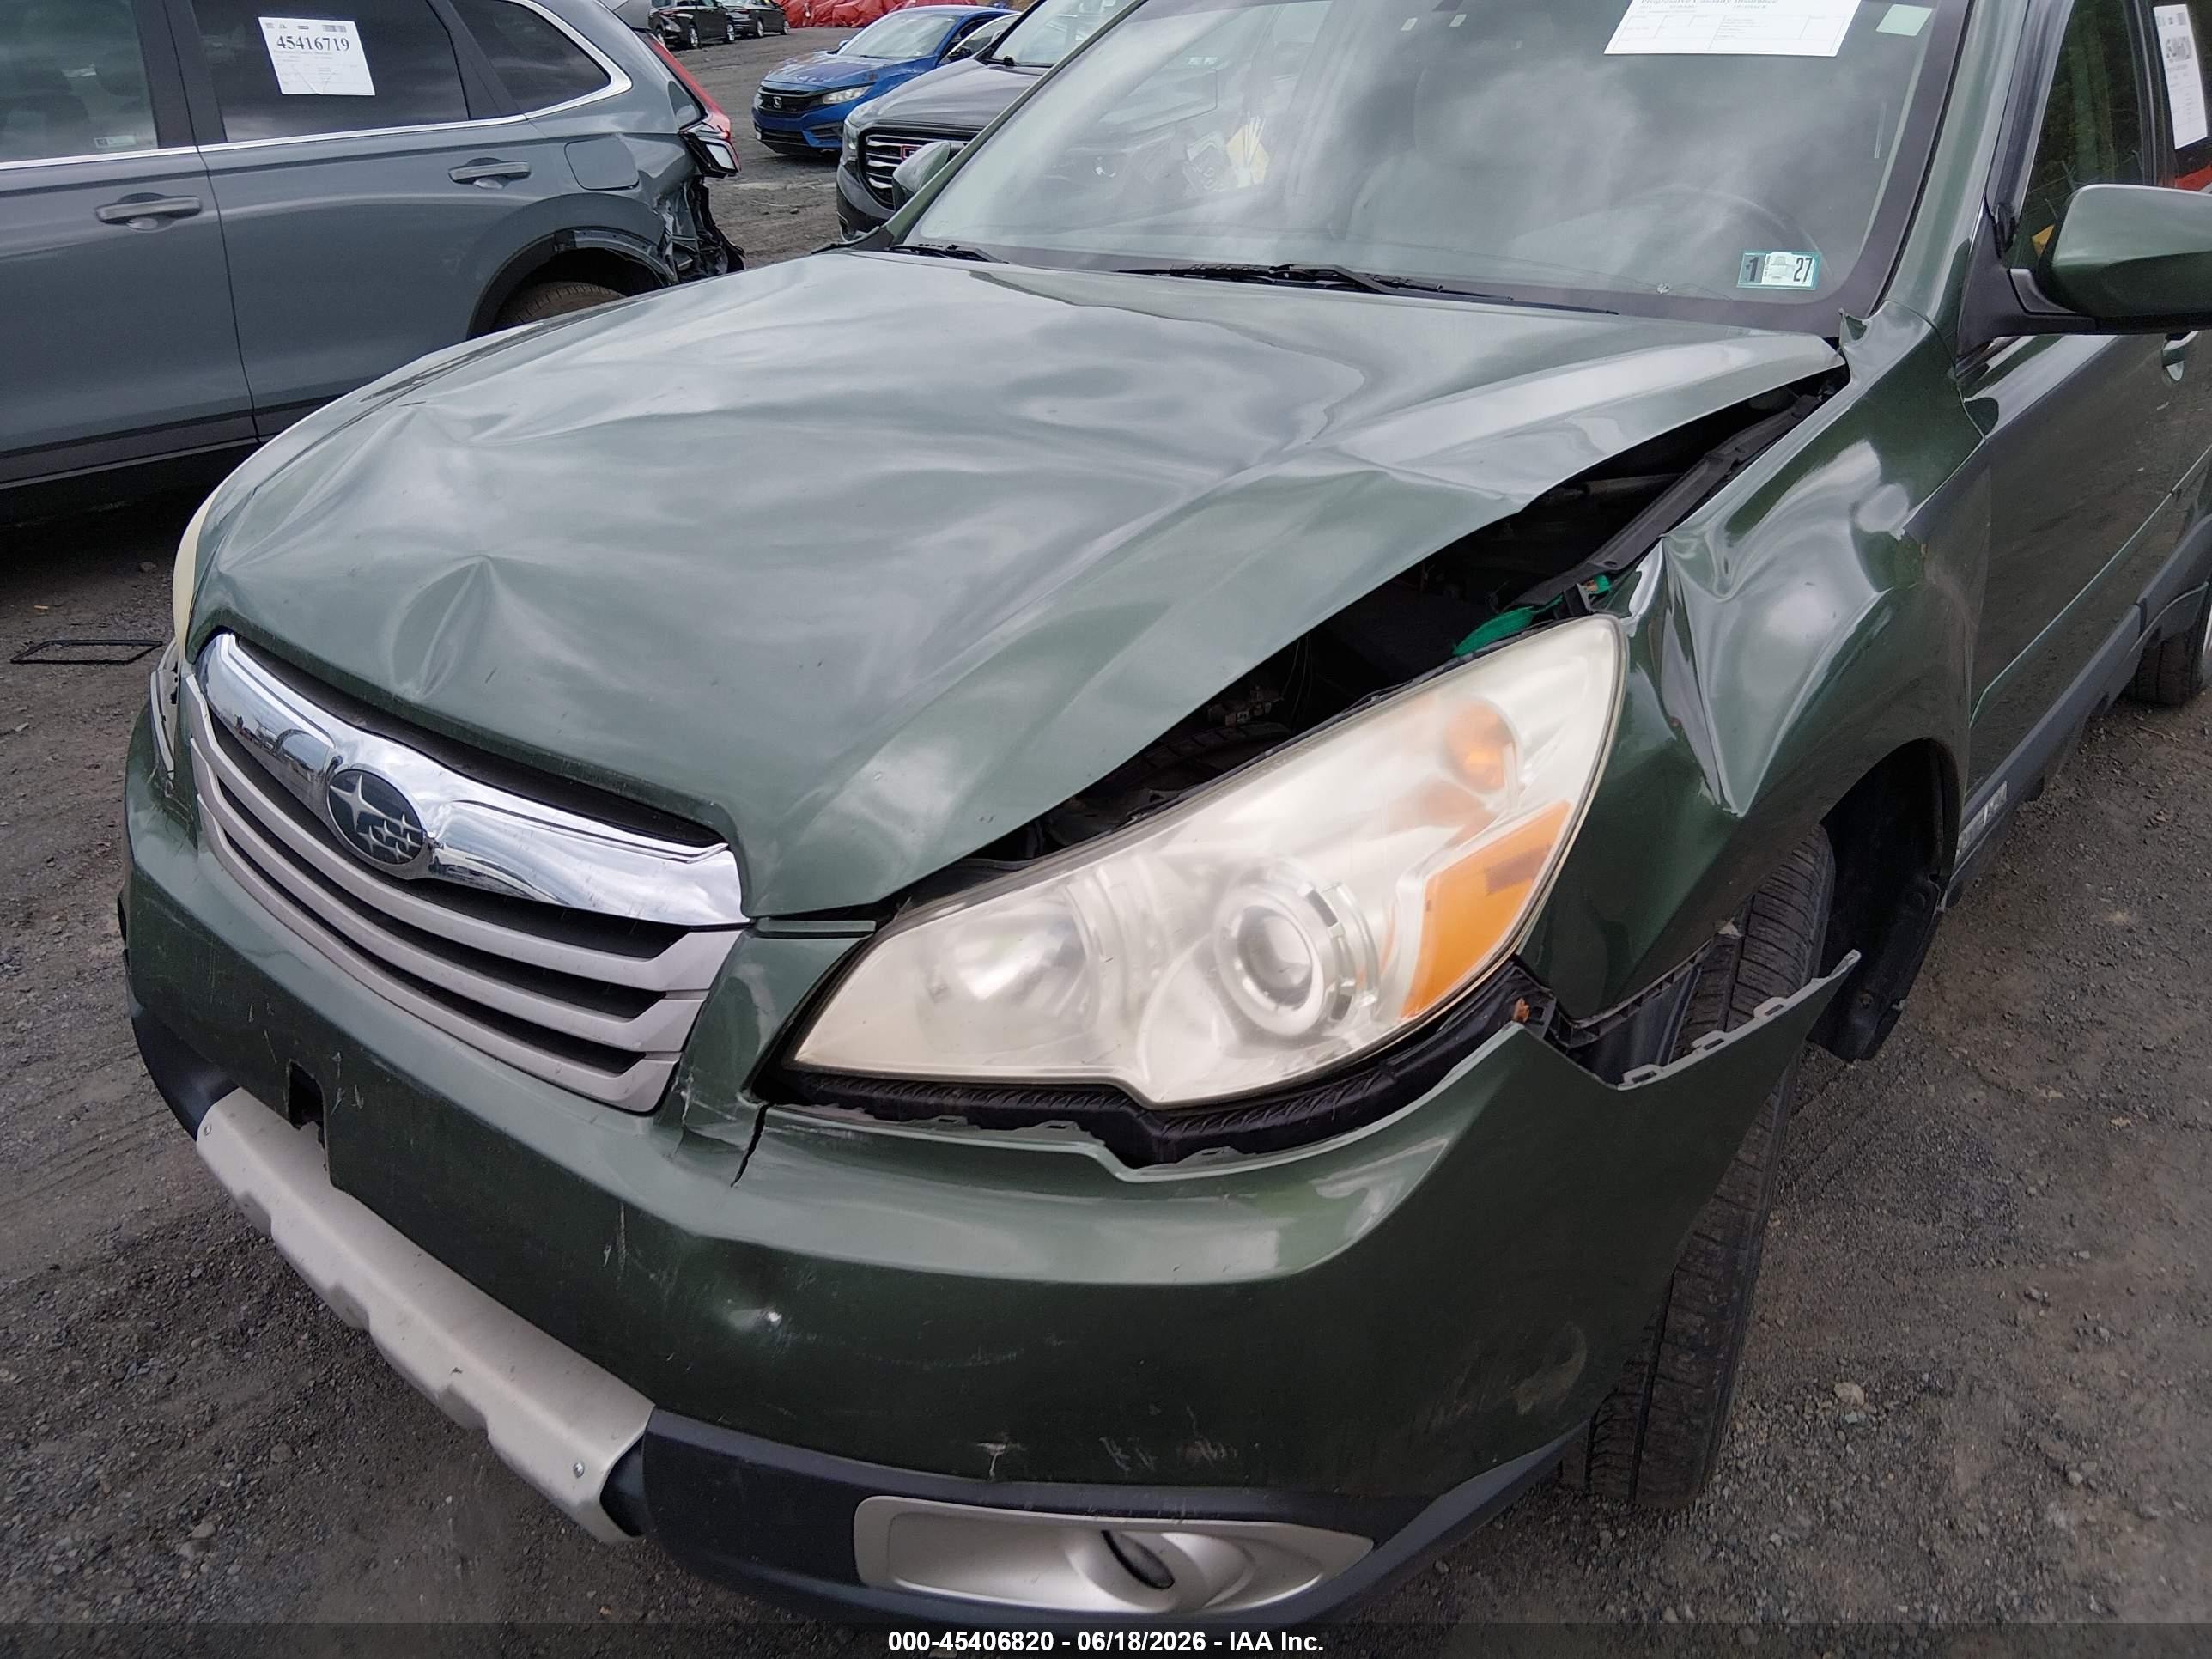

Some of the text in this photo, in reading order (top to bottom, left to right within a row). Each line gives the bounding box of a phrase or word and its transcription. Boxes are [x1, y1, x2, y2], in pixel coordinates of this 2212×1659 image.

[276, 35, 350, 52] 45416719
[1746, 257, 1759, 282] 1
[1793, 257, 1814, 283] 27
